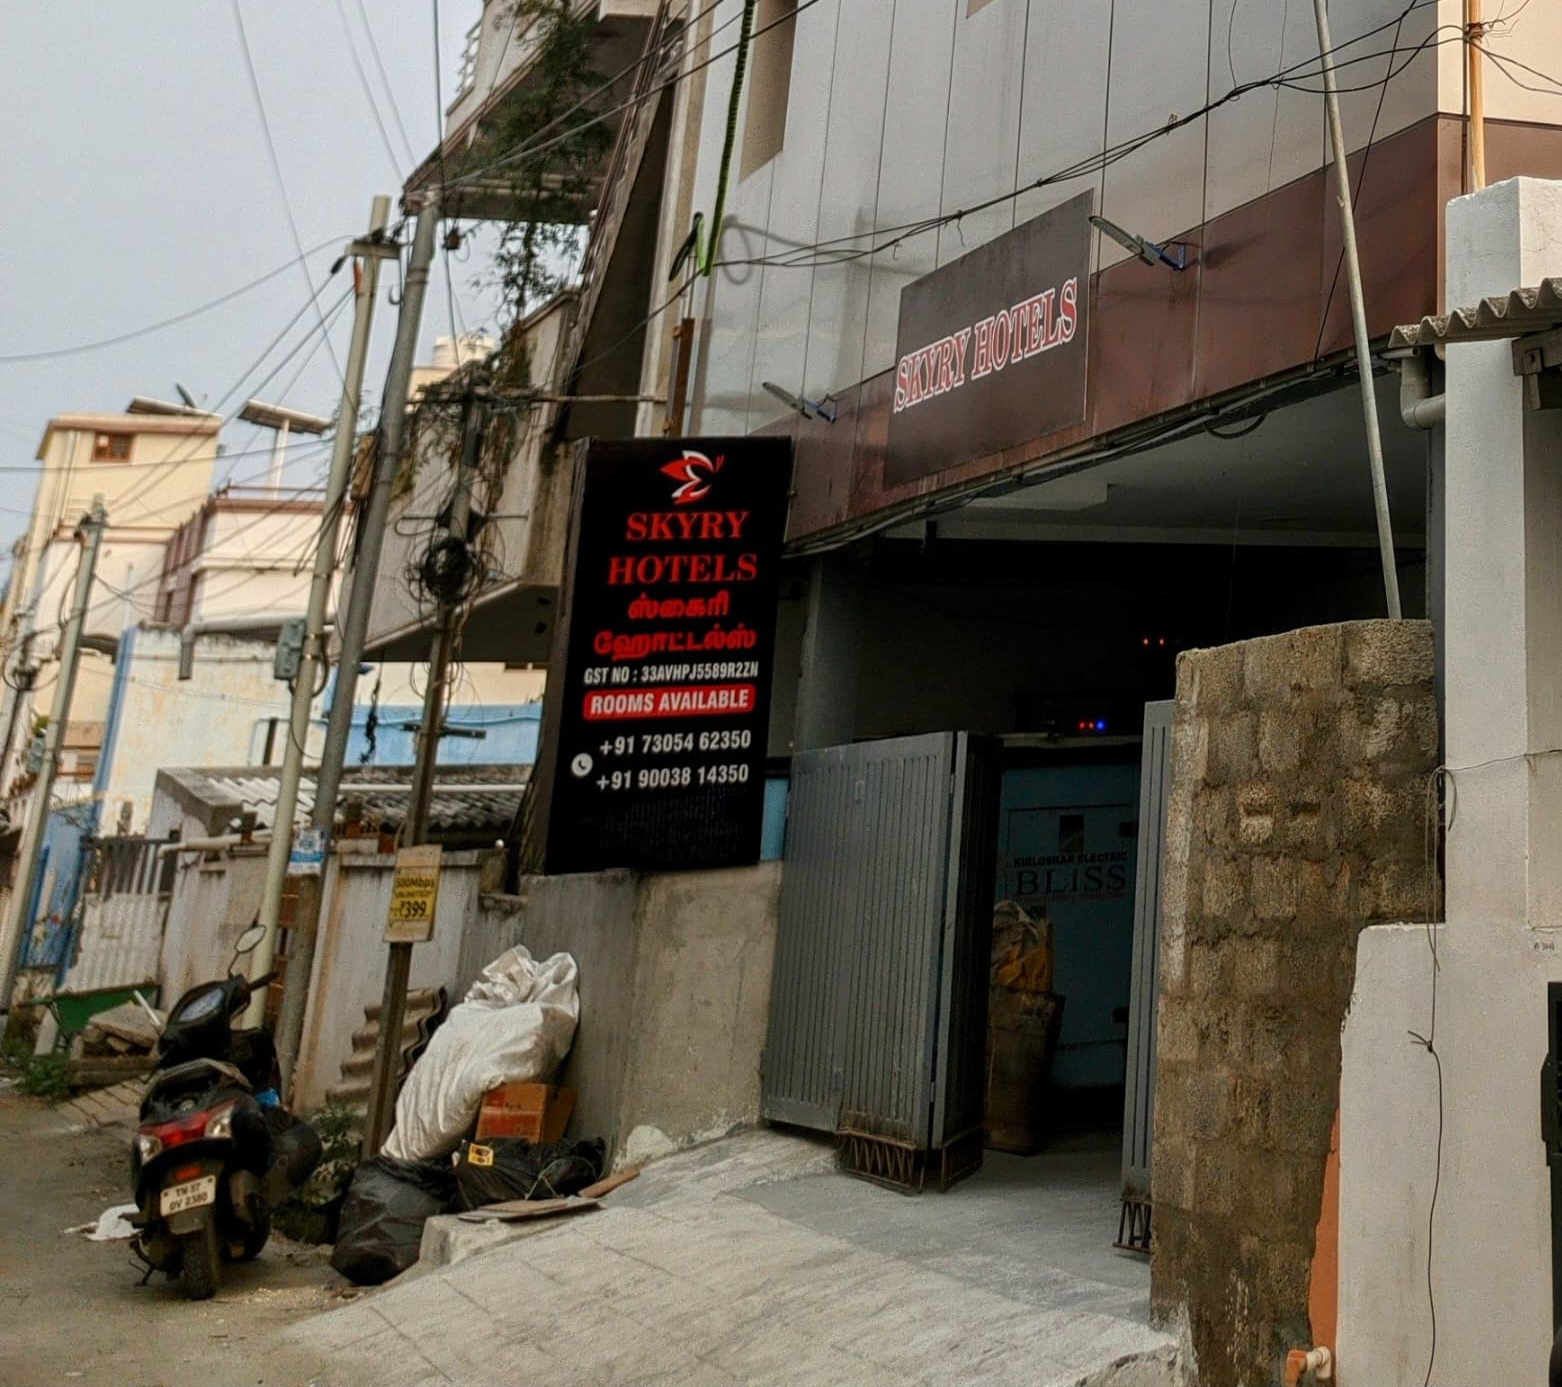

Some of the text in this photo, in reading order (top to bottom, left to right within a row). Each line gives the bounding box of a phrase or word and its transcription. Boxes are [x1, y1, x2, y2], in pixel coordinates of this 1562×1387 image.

[893, 277, 1077, 415] SKYRY HOTELS
[626, 511, 750, 540] SKYRY
[608, 554, 758, 585] HOTELS
[584, 667, 609, 685] GST
[611, 665, 631, 684] NO
[590, 688, 750, 715] ROOMS AVAILABLE
[599, 728, 752, 756] +91 73054 62350
[596, 762, 750, 791] +91 90038 14350
[1014, 850, 1128, 868] KIRLOSKAR ELECTRIC
[176, 1187, 188, 1197] TN
